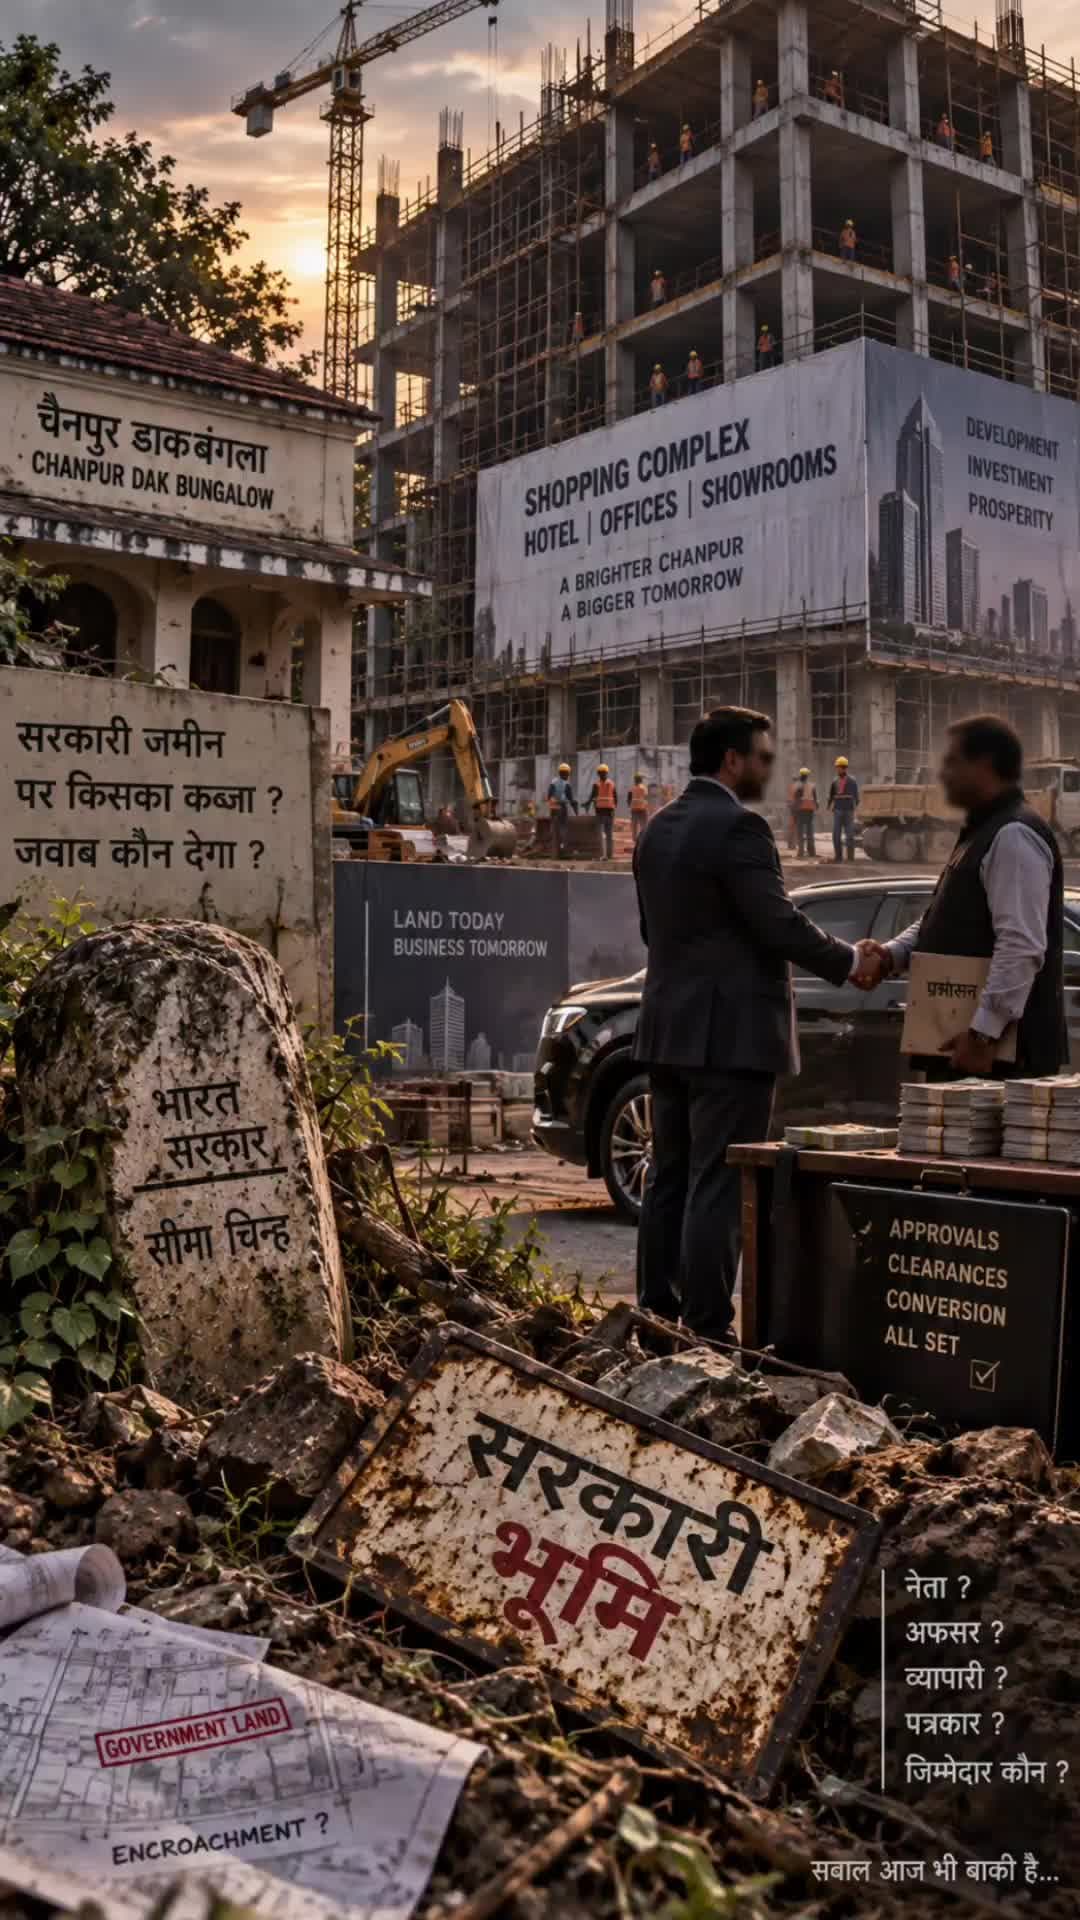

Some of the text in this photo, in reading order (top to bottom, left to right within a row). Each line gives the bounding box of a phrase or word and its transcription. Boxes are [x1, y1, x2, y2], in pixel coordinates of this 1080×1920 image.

[37, 392, 122, 456] चैनपुर
[966, 416, 1060, 461] DEVELOPMENT
[32, 450, 274, 510] CHANPUR DAK BUNGALOW
[524, 418, 750, 517] SHOPPING COMPLEX
[967, 454, 1054, 495] INVESTMENT
[524, 444, 837, 557] HOTEL OFFICES SHOWROOMS
[968, 492, 1054, 532] PROSPERITY
[559, 535, 744, 595] A BRIGHTER CHANPUR
[561, 567, 743, 622] A BIGGER TOMORROW
[16, 715, 226, 758] सरकारी जमीन
[14, 769, 283, 815] पर किसका कब्जा ?
[13, 828, 265, 871] जवाब कौन देगा ?
[393, 909, 504, 931] LAND TODAY
[394, 938, 548, 957] BUSINESS TOMORROW
[152, 1081, 240, 1121] भारत
[163, 1126, 269, 1170] सरकार
[144, 1208, 291, 1267] सीमा चिन्ह
[889, 1218, 1000, 1251] APPROVALS
[888, 1253, 1008, 1289] CLEARANCES
[887, 1288, 1007, 1327] CONVERSION
[884, 1325, 960, 1356] ALL SET
[467, 1410, 775, 1595] सरकारी
[492, 1521, 682, 1662] भूमि
[105, 1707, 281, 1760] GOVERNMENT LAND
[112, 1811, 329, 1865] ENCROACHMENT ?
